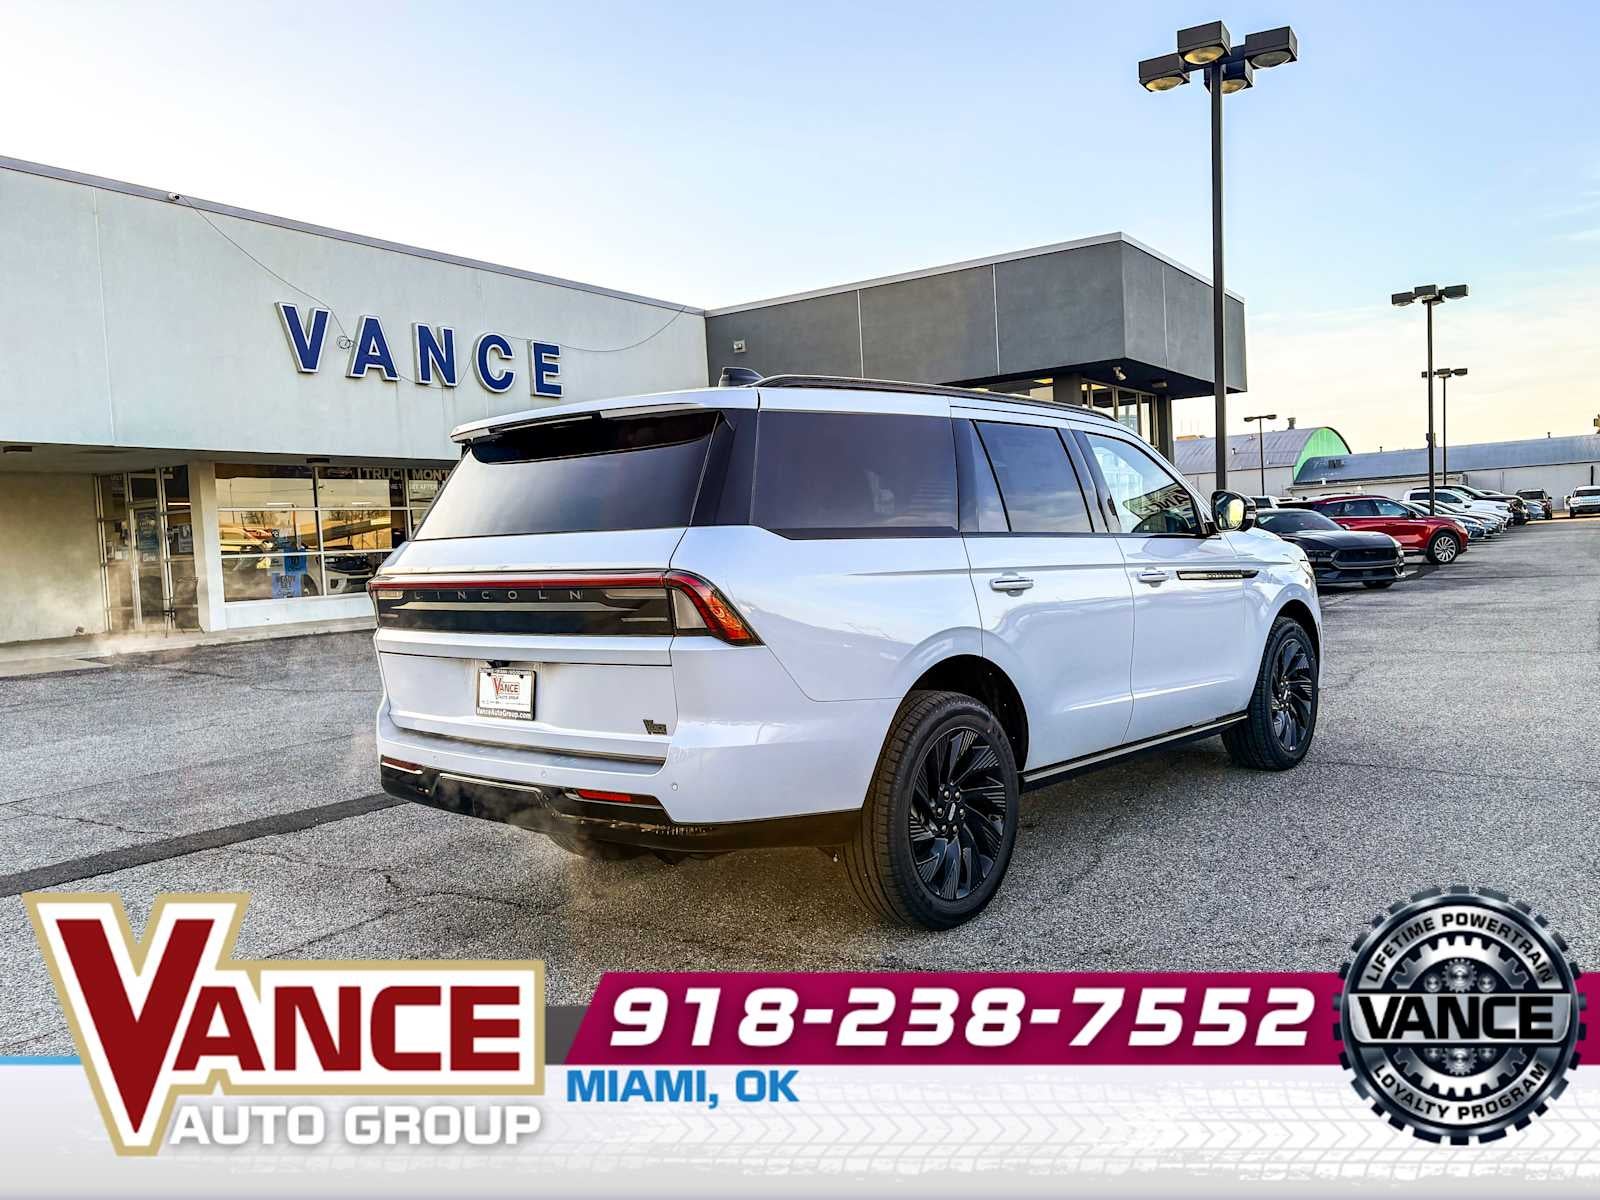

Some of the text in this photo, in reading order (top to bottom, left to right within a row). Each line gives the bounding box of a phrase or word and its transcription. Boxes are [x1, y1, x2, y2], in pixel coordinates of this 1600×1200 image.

[275, 301, 563, 397] VANCE
[362, 468, 450, 482] TRUC MONT
[414, 590, 584, 600] LINCOLN
